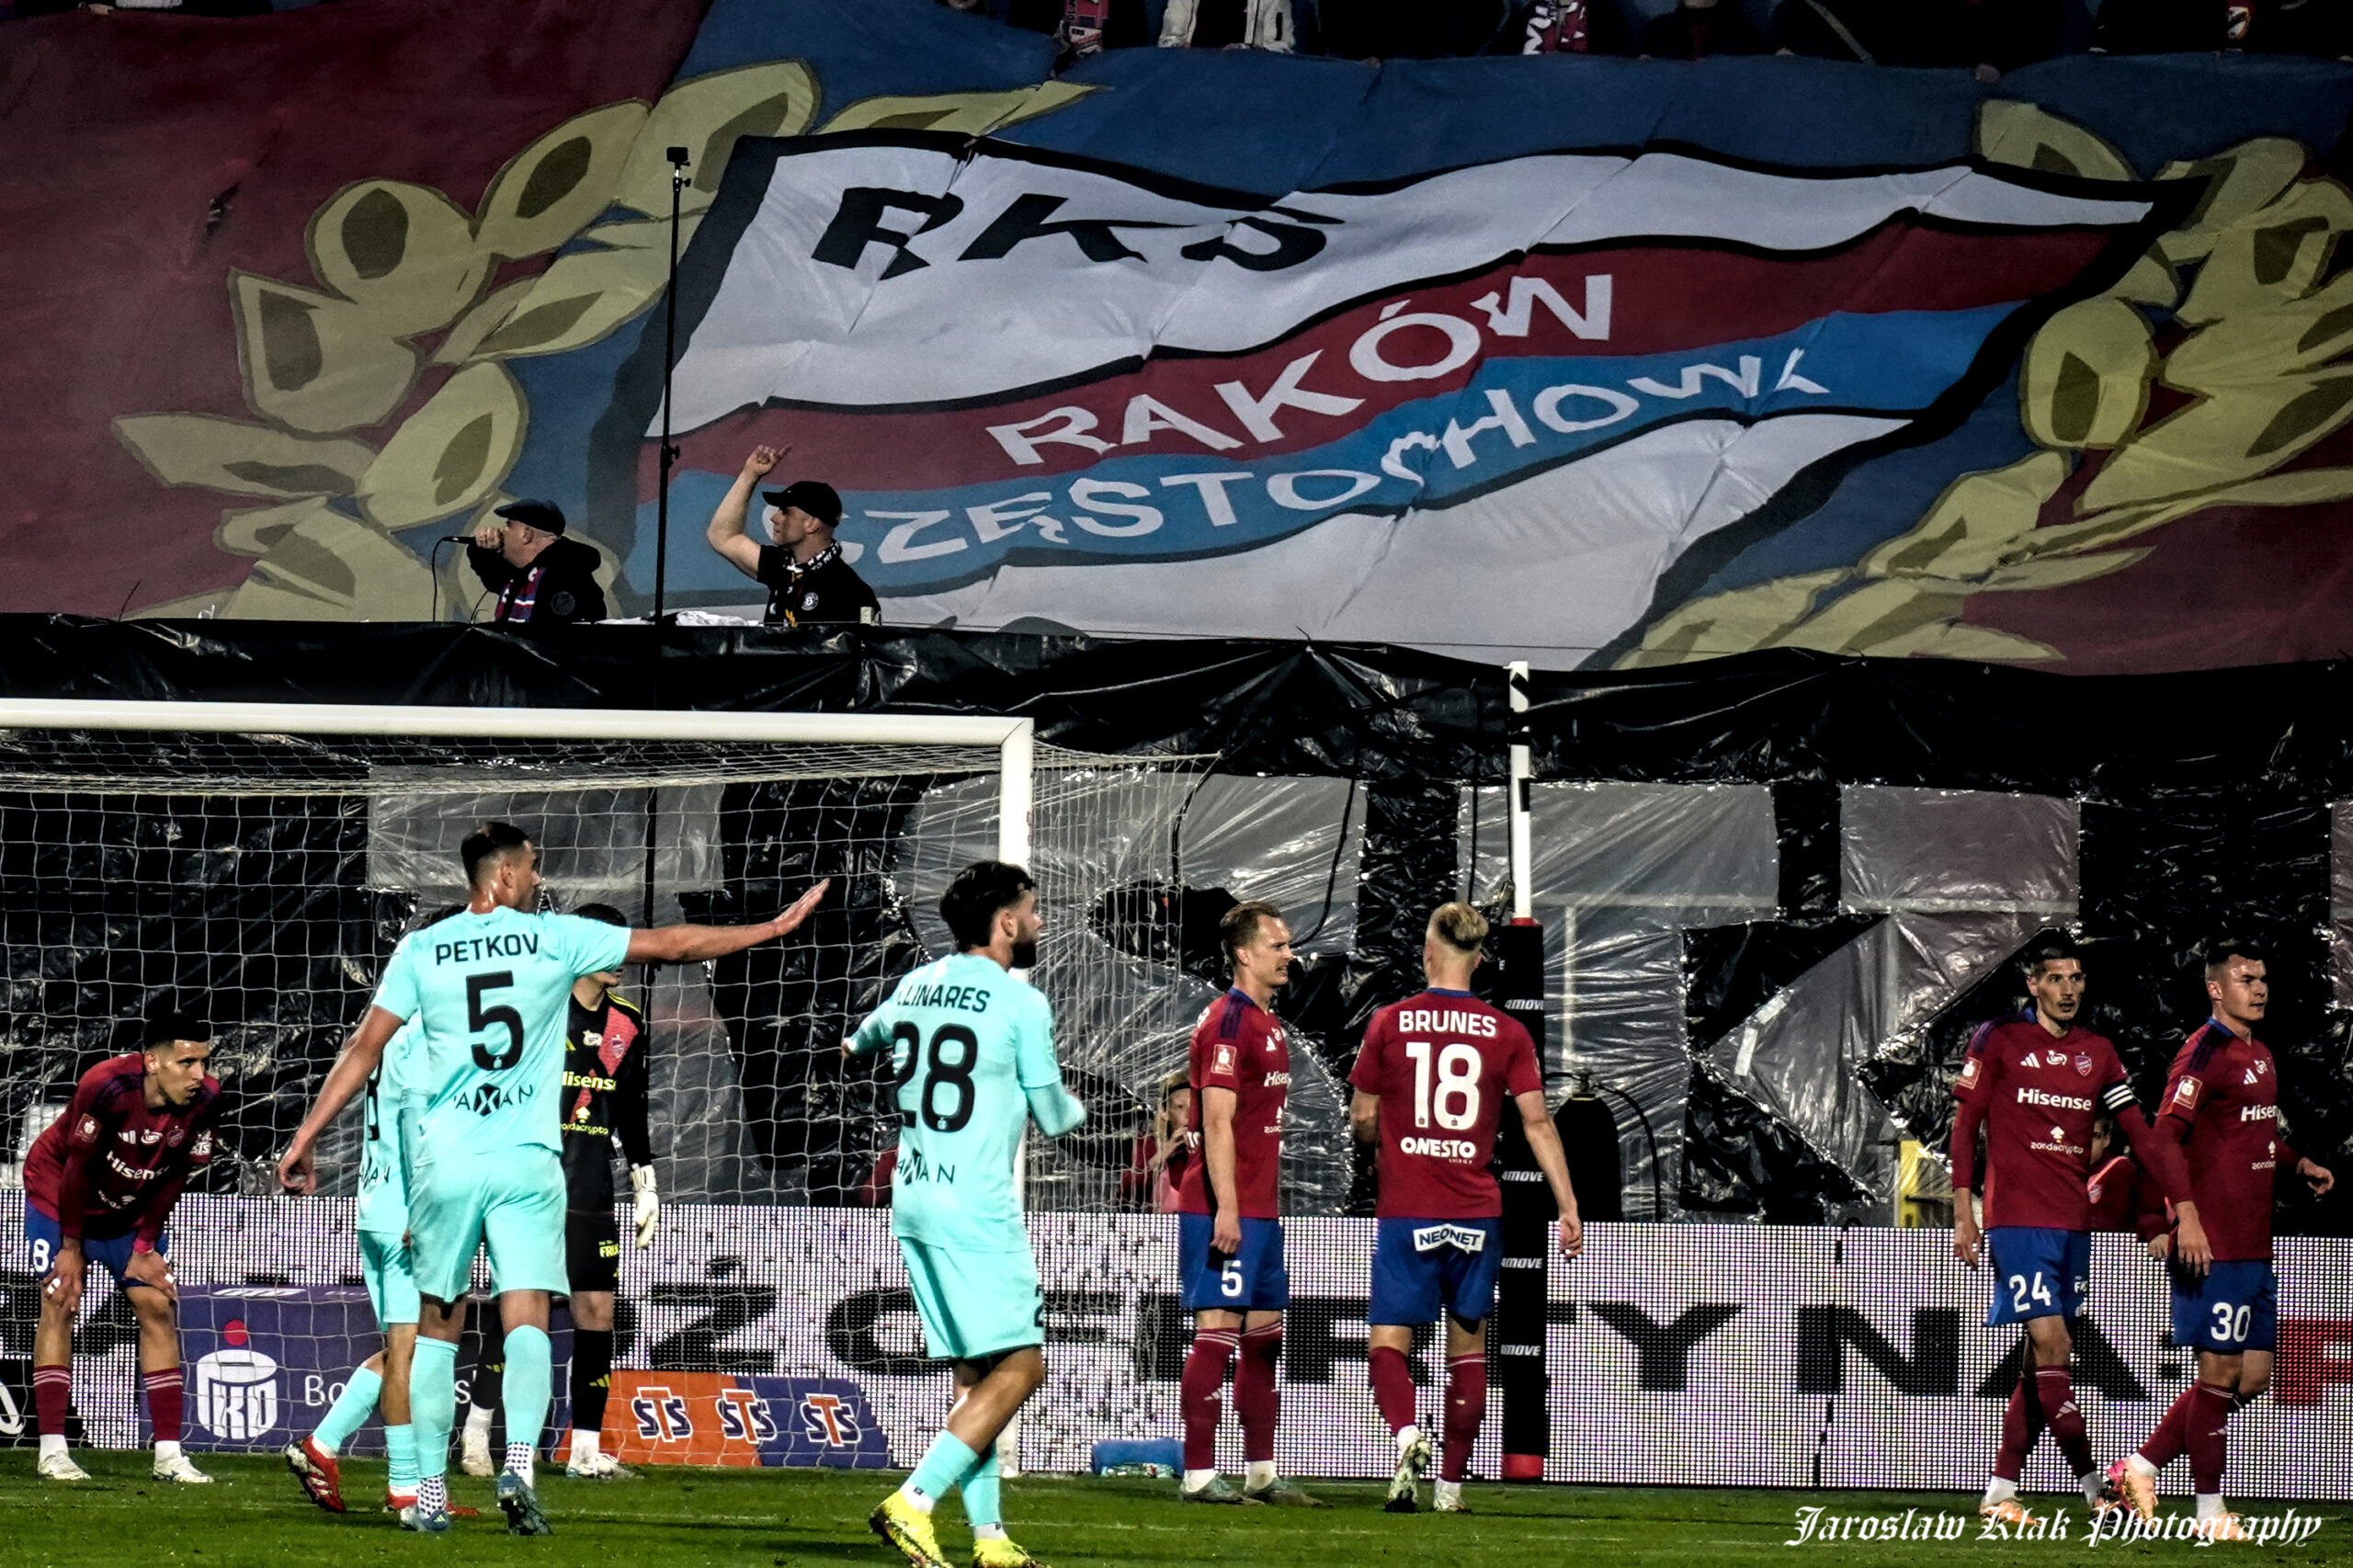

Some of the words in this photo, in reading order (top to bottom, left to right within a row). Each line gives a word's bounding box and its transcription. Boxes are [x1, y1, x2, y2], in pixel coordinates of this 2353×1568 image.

[811, 187, 1345, 281] RKS
[985, 274, 1612, 467] RAKÓW
[435, 932, 540, 967] PETKOV
[465, 971, 525, 1072] 5
[1399, 1010, 1497, 1038] BRUNES
[892, 1021, 978, 1133] 28
[1406, 1041, 1482, 1131] 18
[2017, 1087, 2093, 1111] Hisense
[2241, 1105, 2278, 1122] Hisen
[561, 1121, 609, 1136] ondacrypto
[1400, 1136, 1477, 1158] ONESTO
[106, 1150, 171, 1181] Hisens
[1418, 1228, 1482, 1247] NEONET
[1221, 1260, 1243, 1298] 5
[2009, 1272, 2052, 1313] 24
[2211, 1301, 2252, 1342] 30
[631, 1386, 693, 1443] STS
[716, 1388, 778, 1445] STS
[800, 1392, 862, 1448] STS
